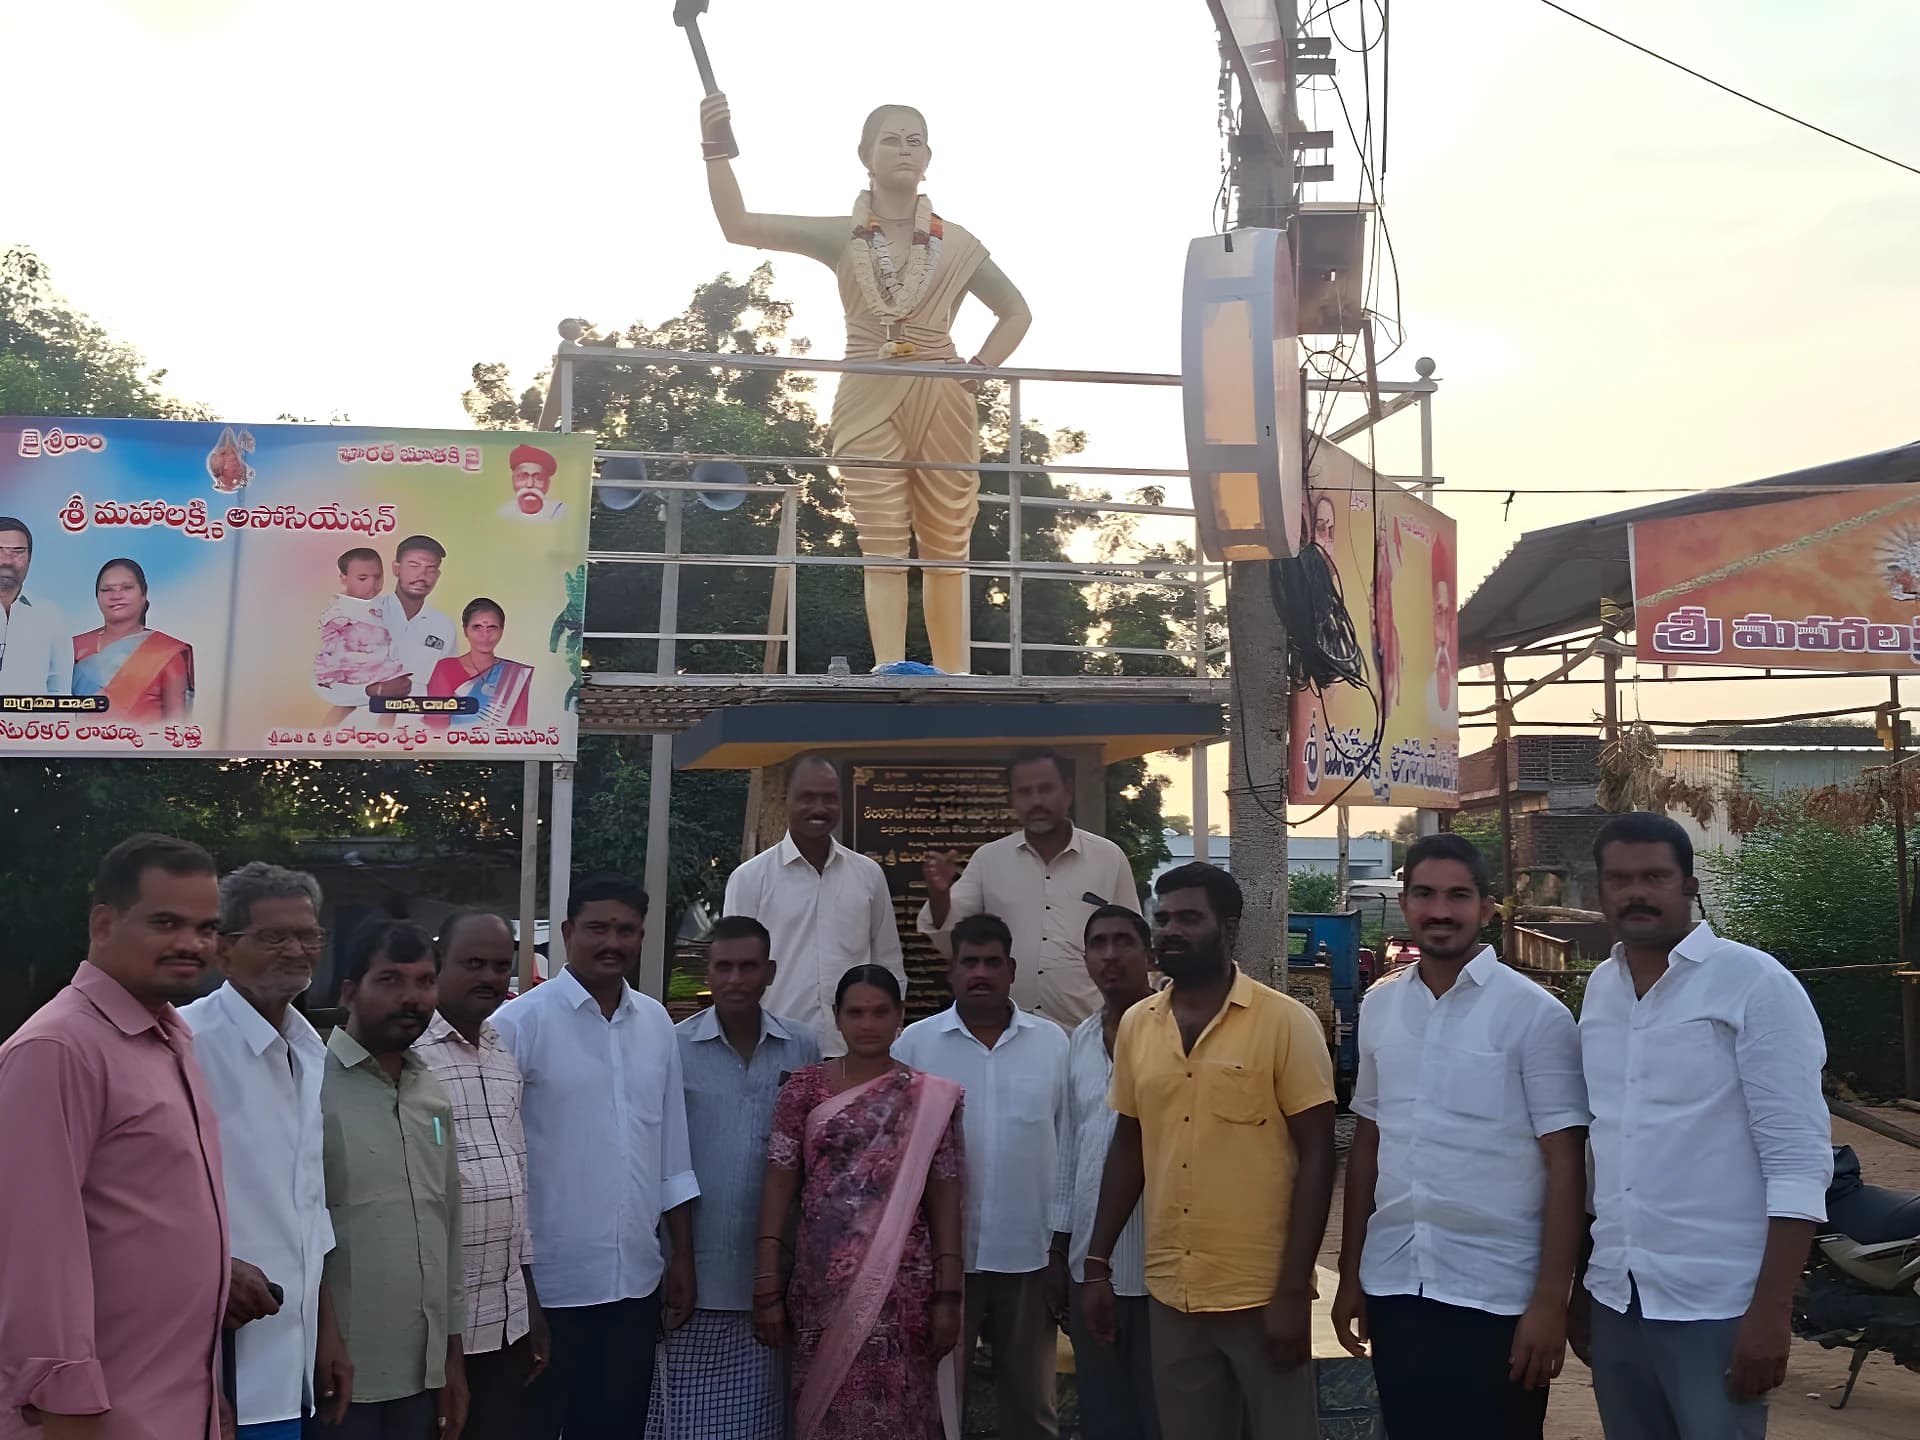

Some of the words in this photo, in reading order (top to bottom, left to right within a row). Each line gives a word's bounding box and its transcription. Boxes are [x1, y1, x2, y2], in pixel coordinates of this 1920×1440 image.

[22, 430, 40, 455] జై
[464, 447, 481, 471] జై
[59, 495, 89, 531] శ్రీ
[227, 503, 396, 536] అసోసియేషన్
[1653, 606, 1723, 654] శ్రీ
[1732, 613, 1920, 665] మహాల
